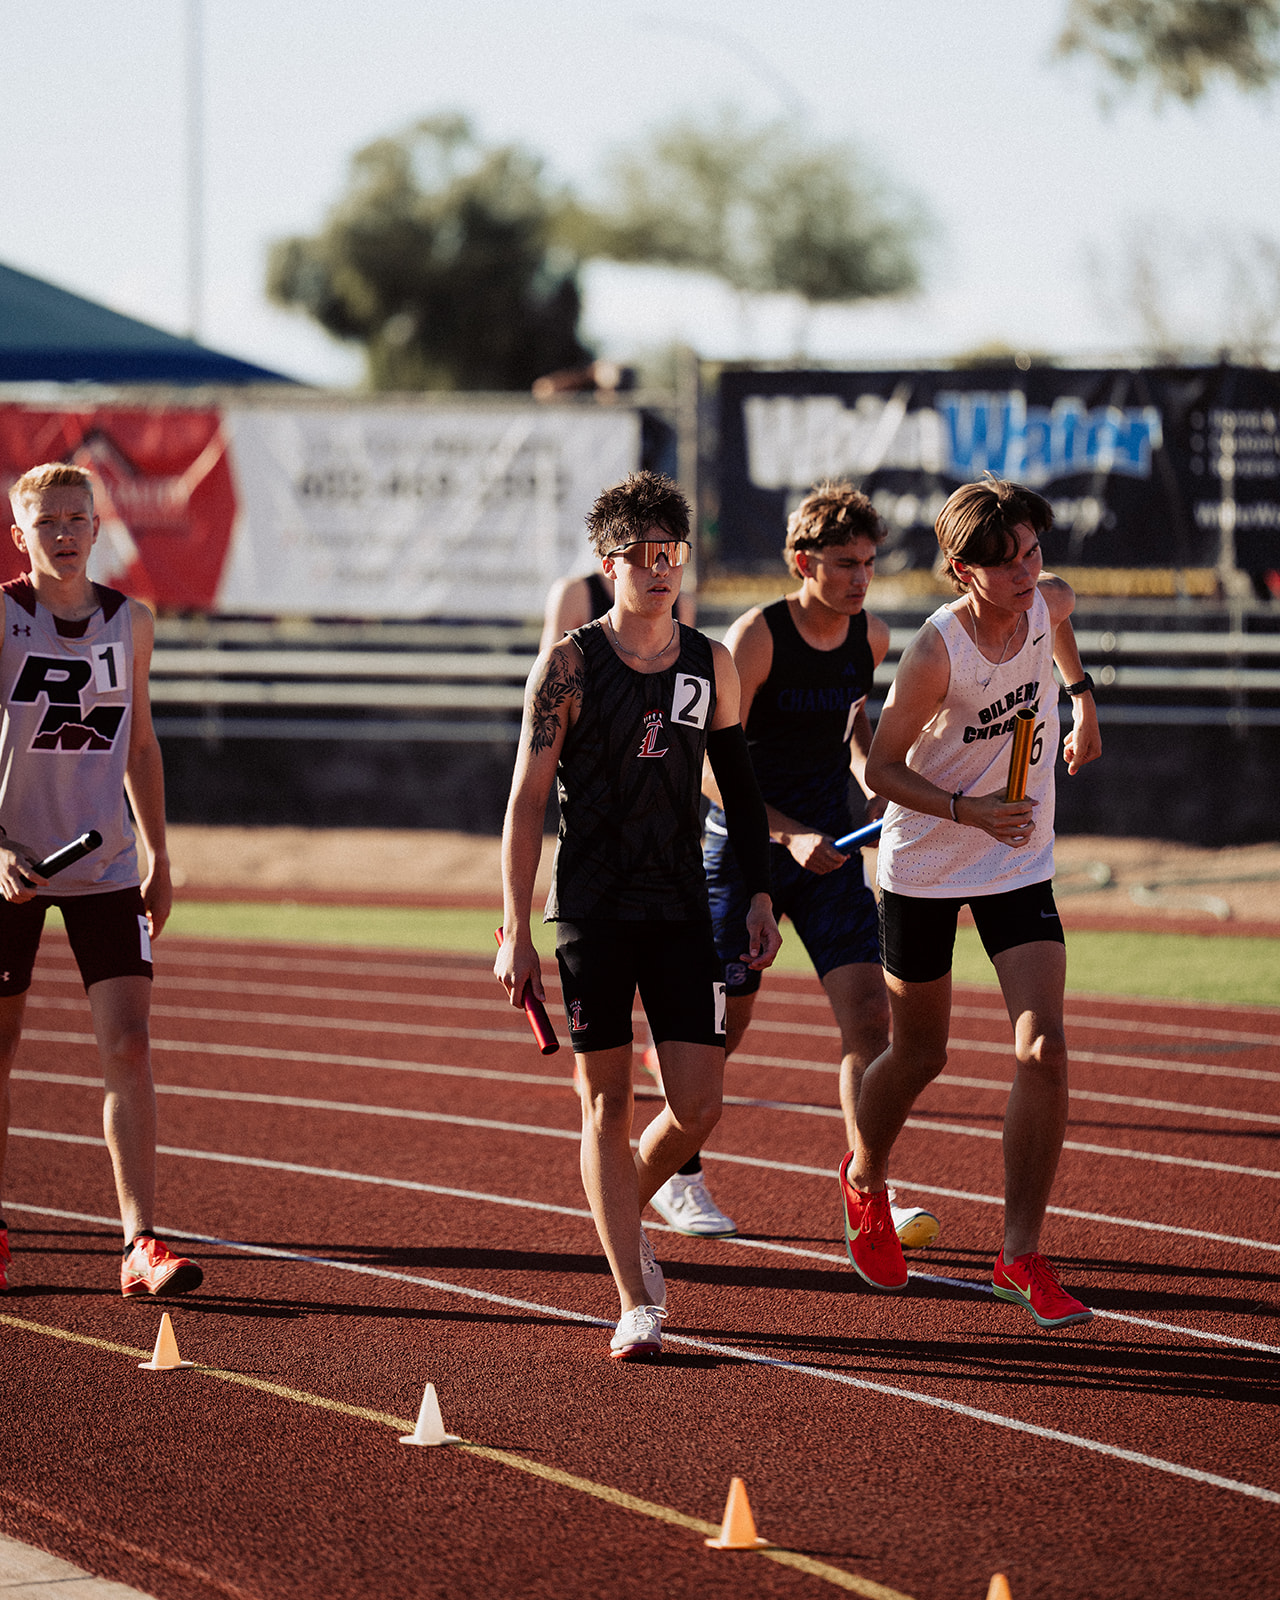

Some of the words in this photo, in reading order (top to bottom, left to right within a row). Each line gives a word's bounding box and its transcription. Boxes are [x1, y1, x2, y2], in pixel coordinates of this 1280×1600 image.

[98, 646, 118, 688] 1
[678, 677, 703, 725] 2
[1029, 721, 1046, 766] 6
